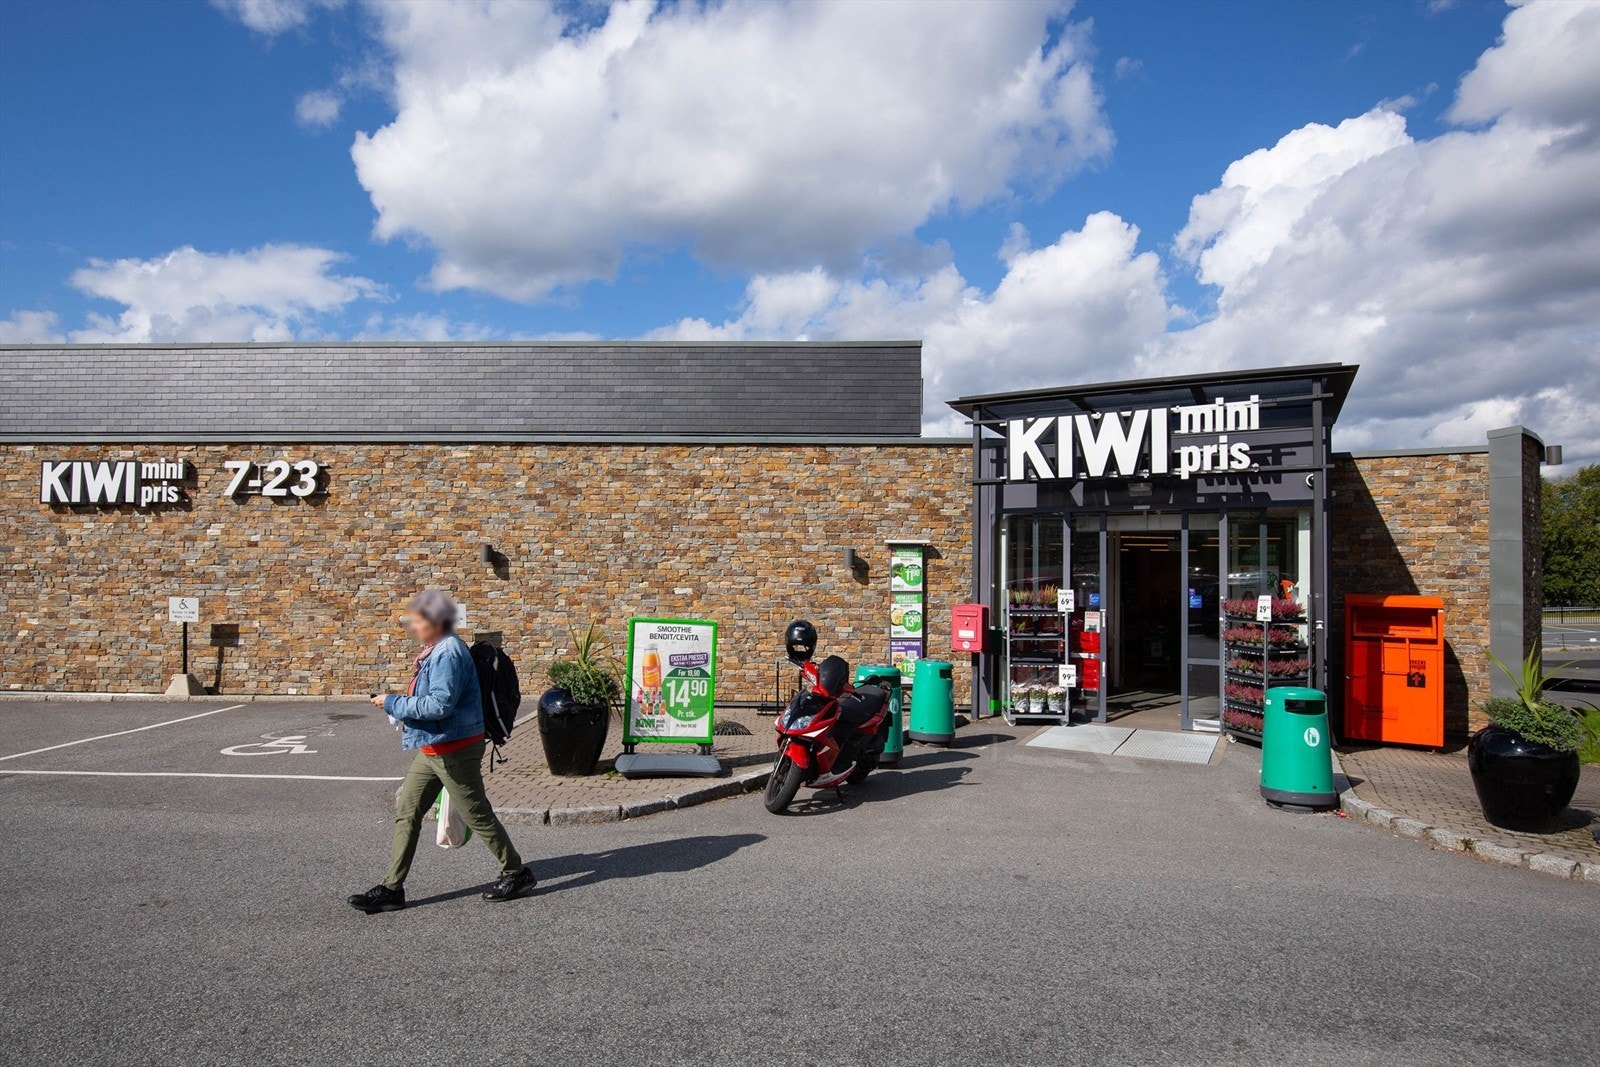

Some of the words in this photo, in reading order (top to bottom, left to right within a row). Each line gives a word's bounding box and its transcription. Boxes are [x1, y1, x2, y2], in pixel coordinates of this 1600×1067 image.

[1009, 407, 1168, 480] KIWI
[1180, 395, 1259, 433] mini
[41, 461, 136, 503] KIWI
[141, 457, 183, 479] mini
[141, 480, 179, 507] pris
[223, 460, 318, 496] 7-23
[649, 633, 699, 641] BENDIT/CEVITA
